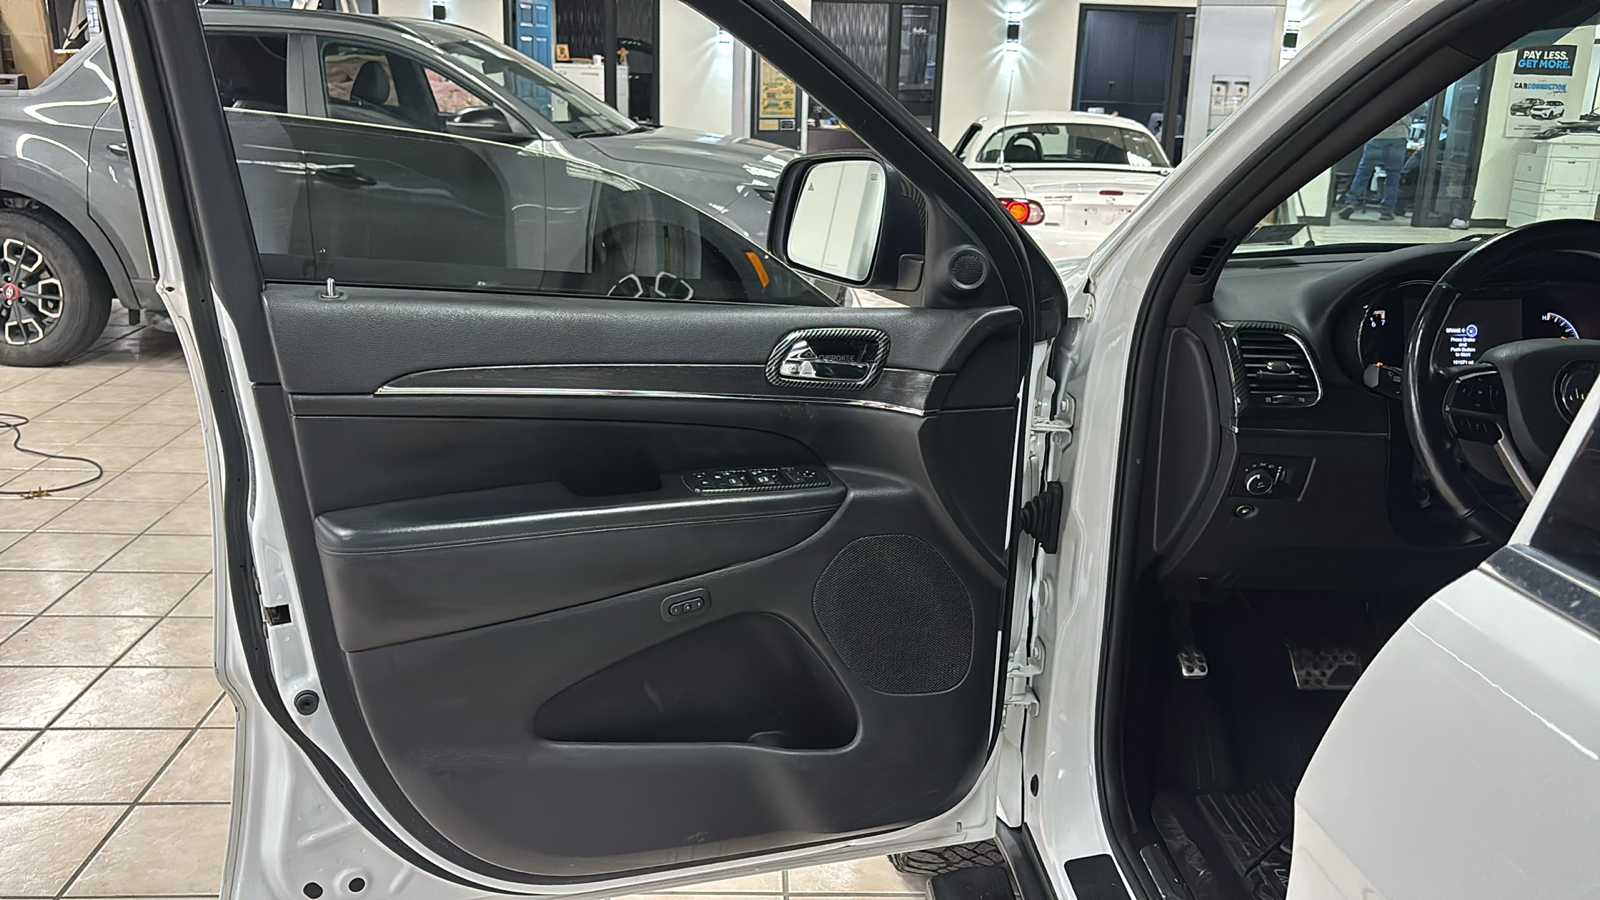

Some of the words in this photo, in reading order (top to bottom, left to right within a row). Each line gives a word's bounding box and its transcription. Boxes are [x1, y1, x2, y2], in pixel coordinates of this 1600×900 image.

[1523, 50, 1543, 59] PAY
[1544, 51, 1569, 60] LESS.
[1518, 59, 1539, 68] GET
[1540, 60, 1571, 69] MORE.
